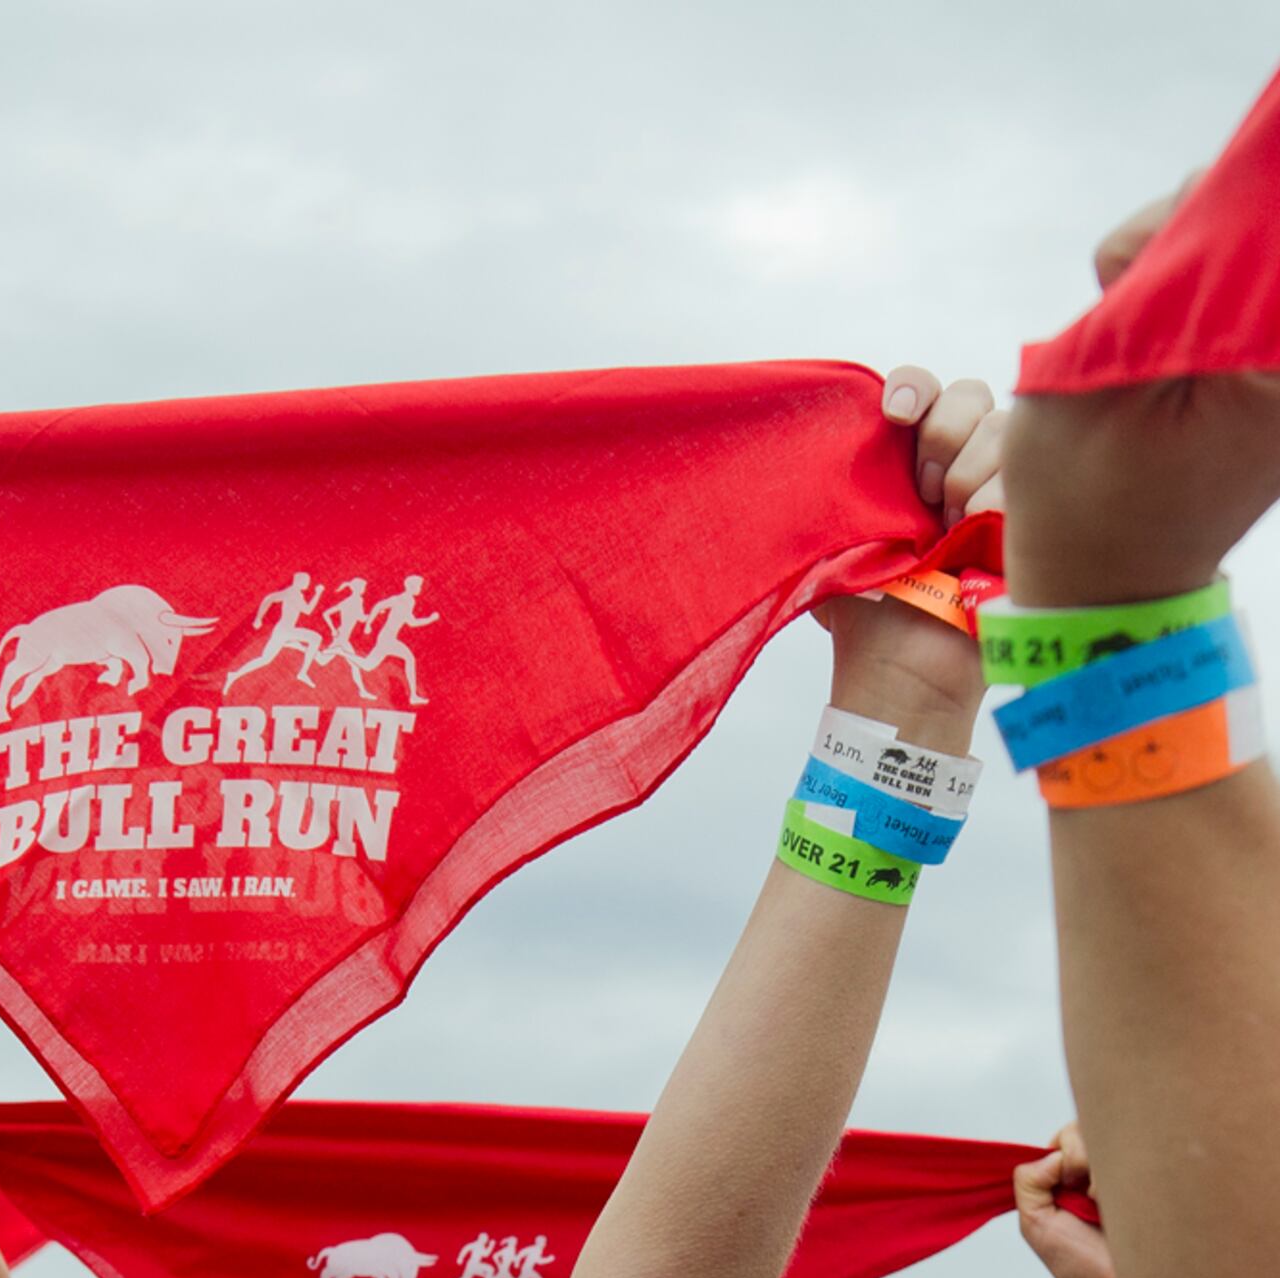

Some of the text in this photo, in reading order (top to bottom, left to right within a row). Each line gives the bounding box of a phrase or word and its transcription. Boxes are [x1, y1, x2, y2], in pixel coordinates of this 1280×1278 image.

[1025, 638, 1065, 668] 21
[161, 704, 417, 774] GREAT
[823, 733, 865, 764] 1 p.m.
[873, 772, 932, 798] BULL RUN
[877, 761, 936, 786] THE GREAT
[947, 776, 957, 792] 1
[820, 782, 849, 809] Beer
[216, 778, 401, 862] RUN
[885, 814, 931, 847] Ticket
[781, 827, 861, 880] OVER 21
[56, 877, 297, 900] I CAME. I SAW. I RAN.
